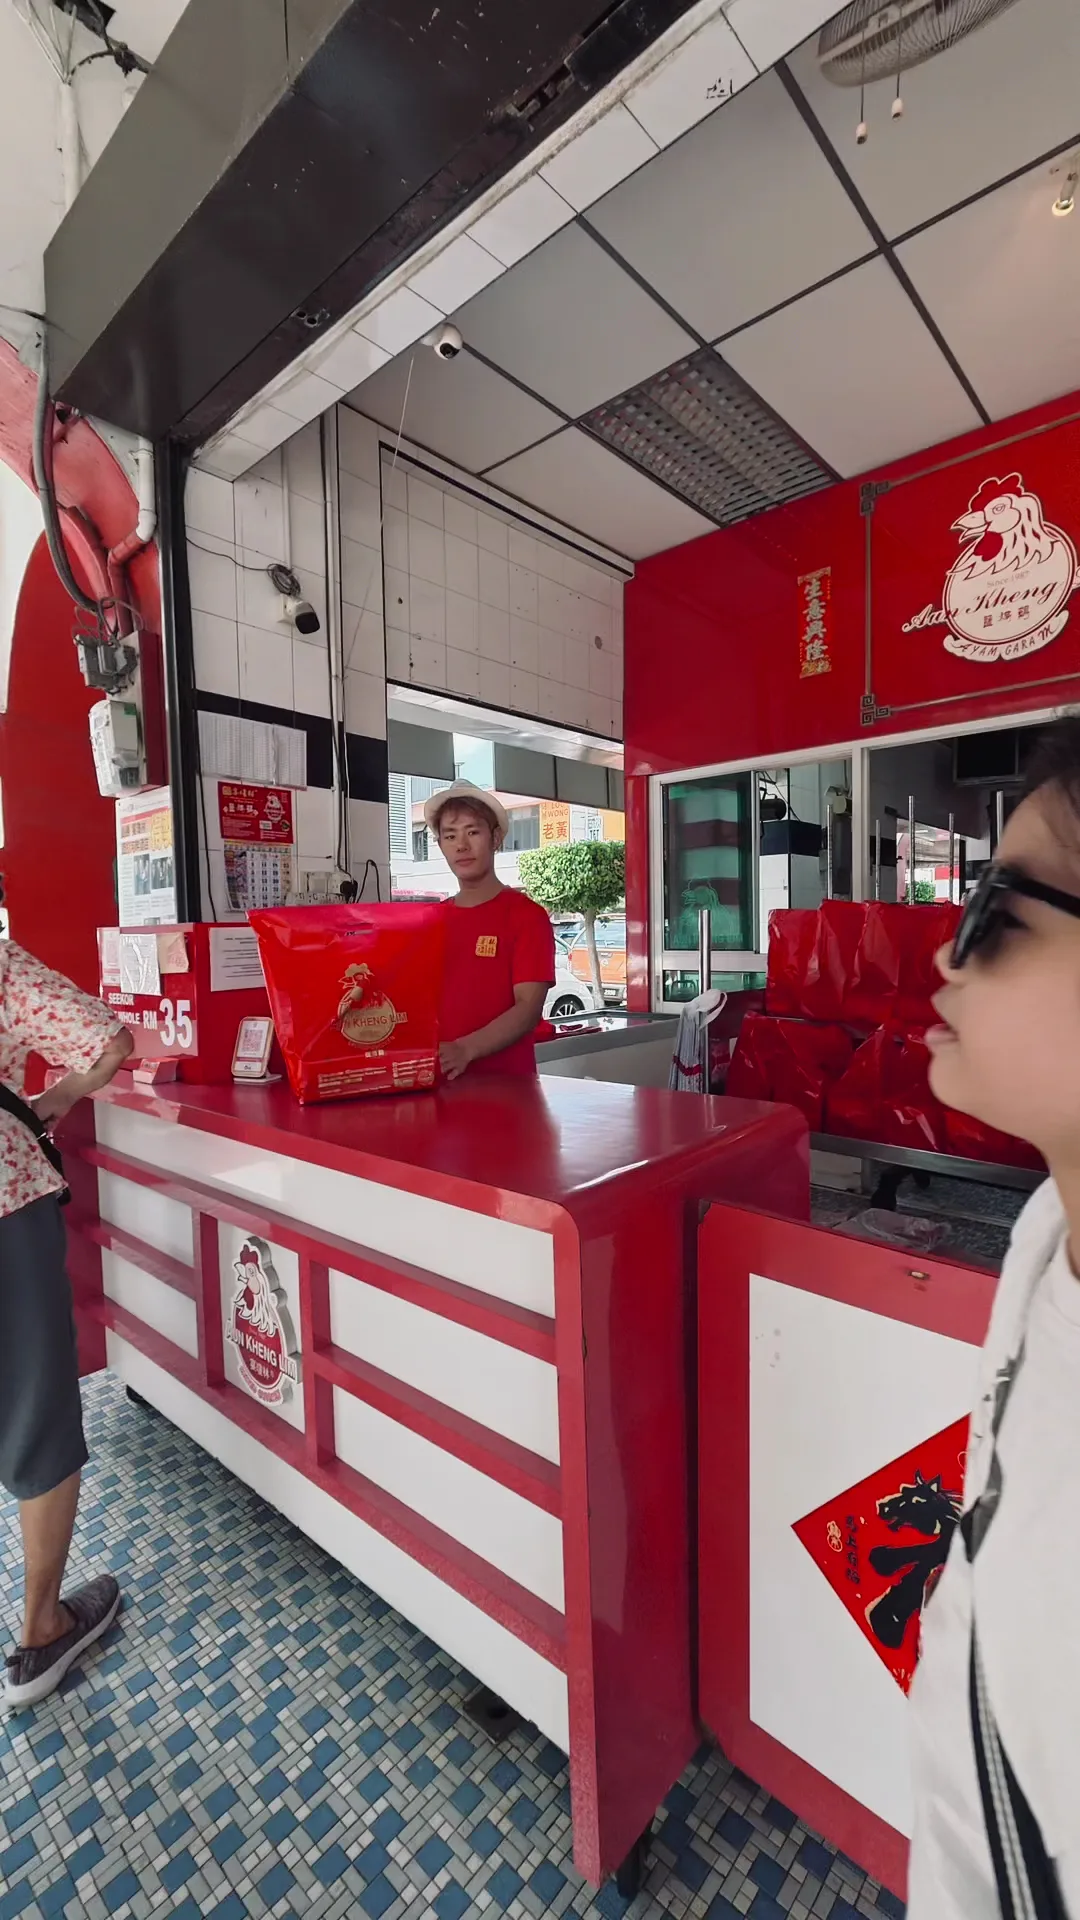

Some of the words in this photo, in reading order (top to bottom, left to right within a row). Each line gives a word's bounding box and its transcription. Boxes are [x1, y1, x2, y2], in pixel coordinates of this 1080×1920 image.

[966, 581, 1058, 614] Kheng
[951, 643, 998, 656] AYAM
[1005, 623, 1058, 656] GARAM
[108, 993, 135, 1006] SEEKOR
[118, 1011, 140, 1025] WHOLE
[143, 1010, 158, 1030] RM
[159, 998, 193, 1048] 35
[352, 1014, 389, 1028] KHENG
[245, 1333, 278, 1367] KHENG
